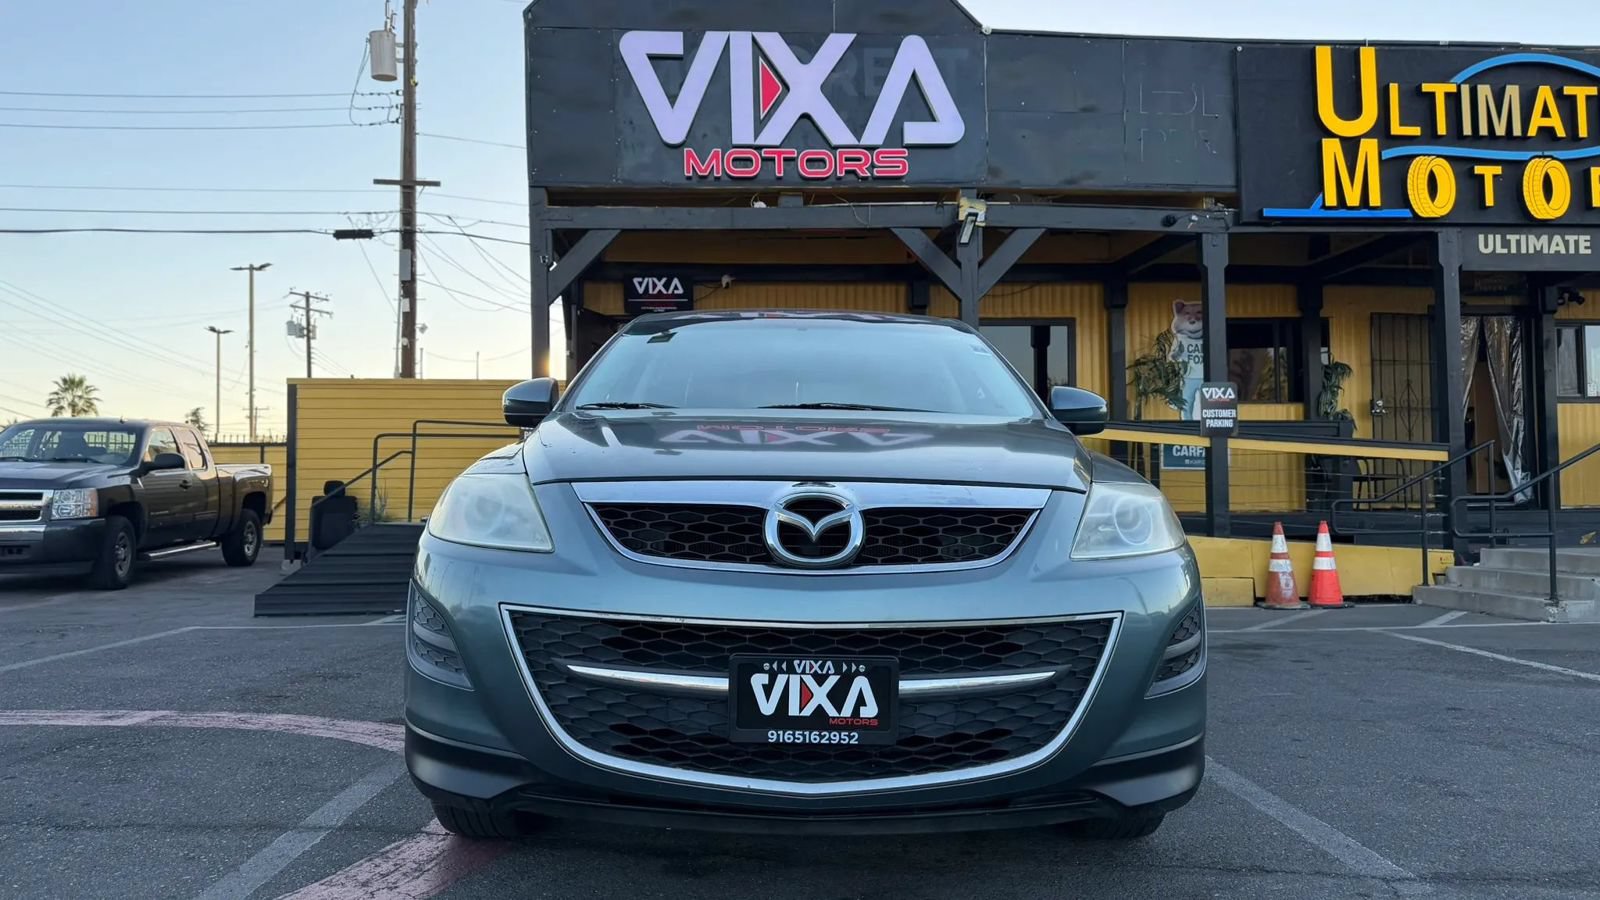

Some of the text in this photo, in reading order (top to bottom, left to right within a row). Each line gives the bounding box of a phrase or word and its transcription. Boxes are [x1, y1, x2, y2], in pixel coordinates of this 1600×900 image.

[618, 30, 966, 147] VIXA
[683, 147, 909, 179] MOTORS
[1478, 233, 1592, 255] ULTIMATE
[632, 276, 684, 295] VIXA
[1187, 344, 1203, 354] CA
[1202, 388, 1235, 399] VIXA
[1203, 409, 1236, 418] CUSTOMER
[1206, 419, 1233, 428] PARKING
[793, 660, 834, 674] VIXA
[750, 673, 879, 718] VIXA
[829, 718, 878, 726] MOTORS
[767, 730, 859, 745] 9165162952
